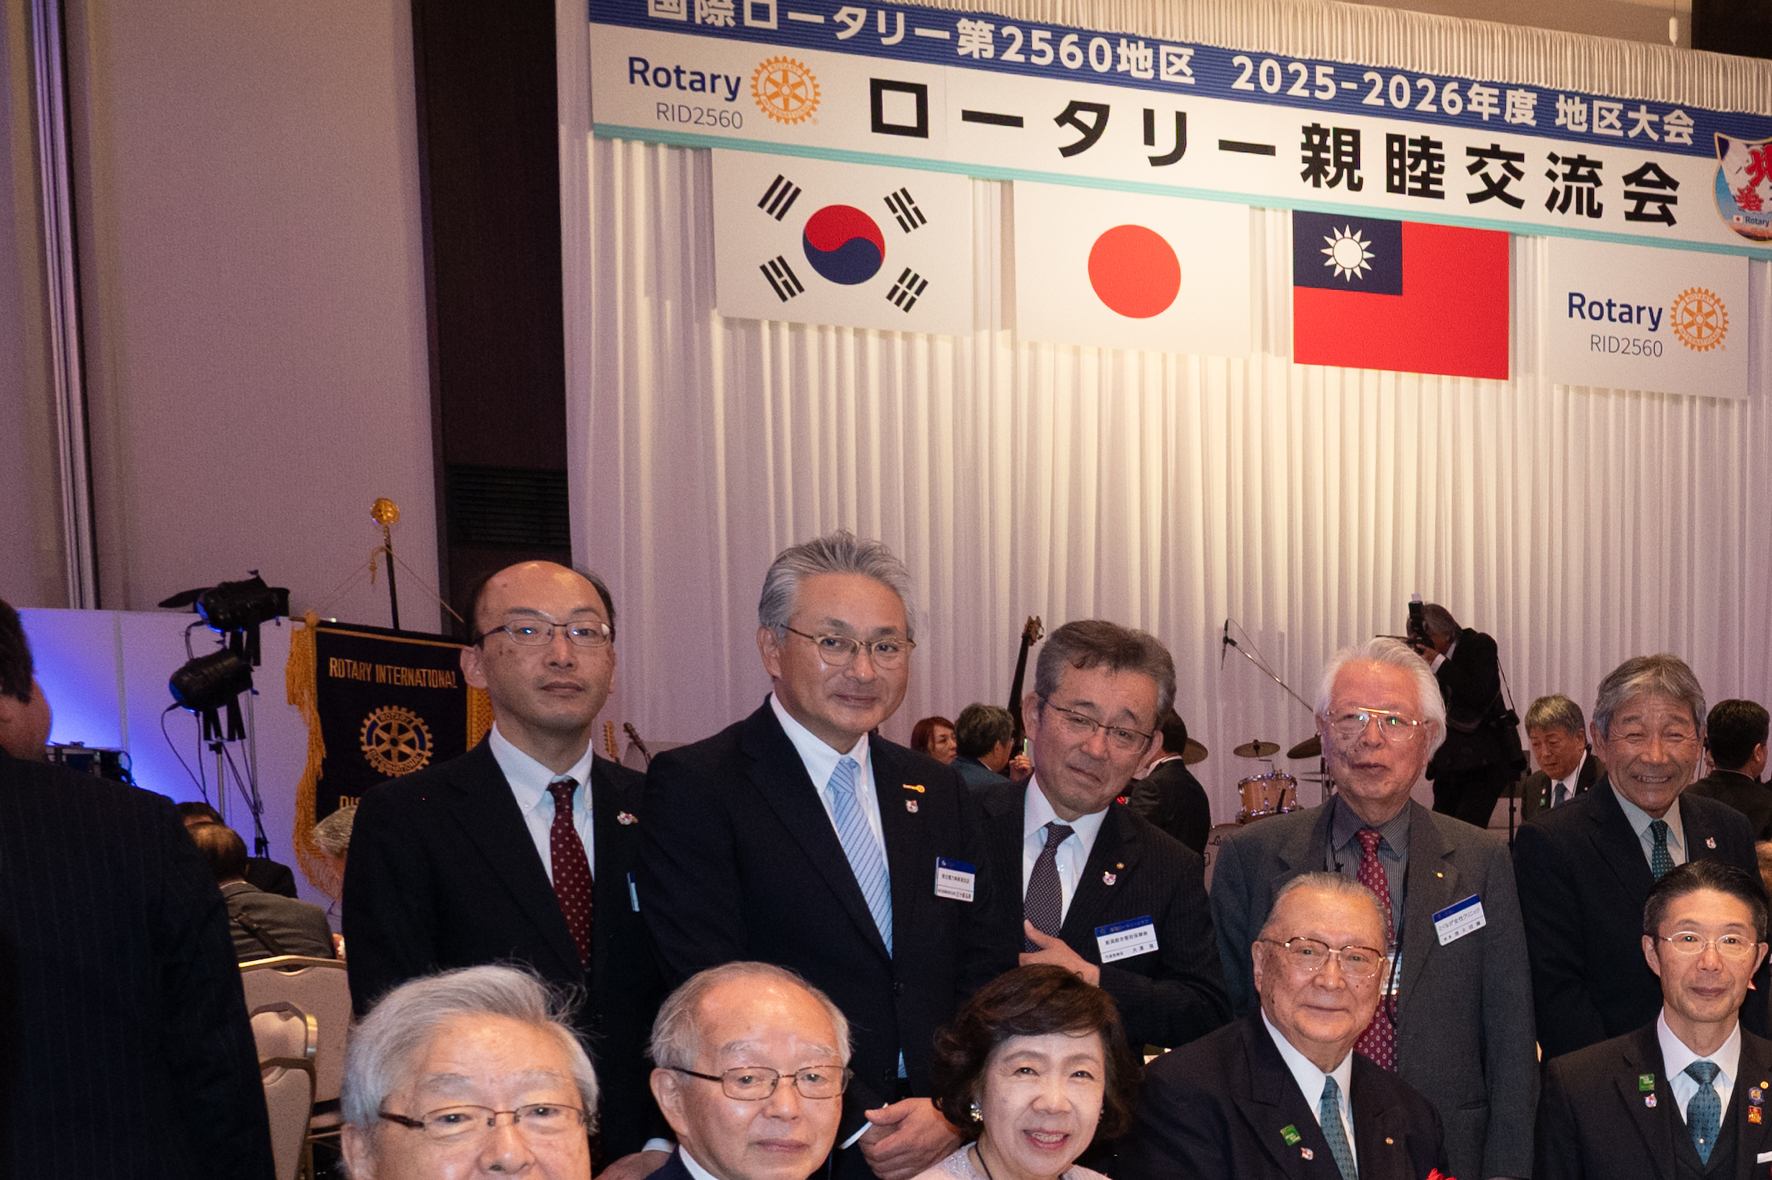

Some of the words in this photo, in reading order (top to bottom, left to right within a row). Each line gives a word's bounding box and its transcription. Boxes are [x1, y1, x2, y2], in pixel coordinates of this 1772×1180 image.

[628, 56, 741, 102] Rotary
[656, 102, 743, 129] RID2560
[1231, 54, 1538, 127] 2025-2026年度
[1555, 94, 1695, 146] 地区大会
[869, 77, 1681, 228] ロータリー親睦交流会
[1744, 215, 1770, 228] Rotary
[1568, 291, 1663, 332] Rotary
[1590, 333, 1663, 358] RID2560
[329, 656, 372, 682] ROTARY
[375, 663, 458, 689] INTERNATIONAL
